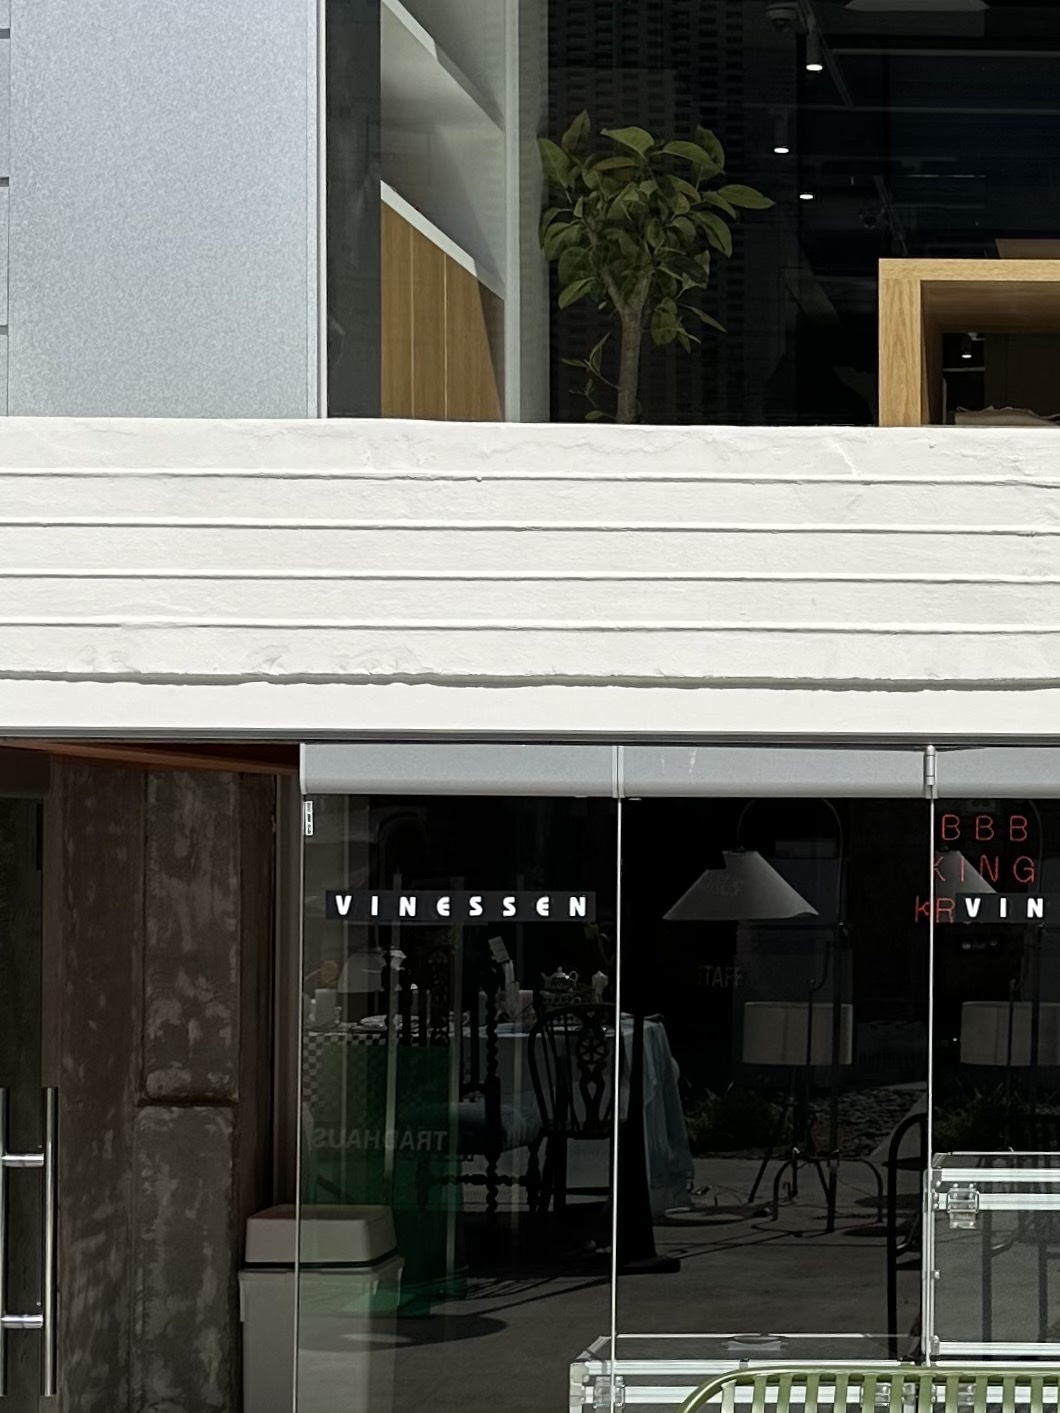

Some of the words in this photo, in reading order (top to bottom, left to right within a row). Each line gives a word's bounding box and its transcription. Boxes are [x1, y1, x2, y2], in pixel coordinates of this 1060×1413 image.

[940, 813, 1029, 842] BBB
[931, 853, 1036, 884] KING
[335, 895, 586, 917] VINESSEN
